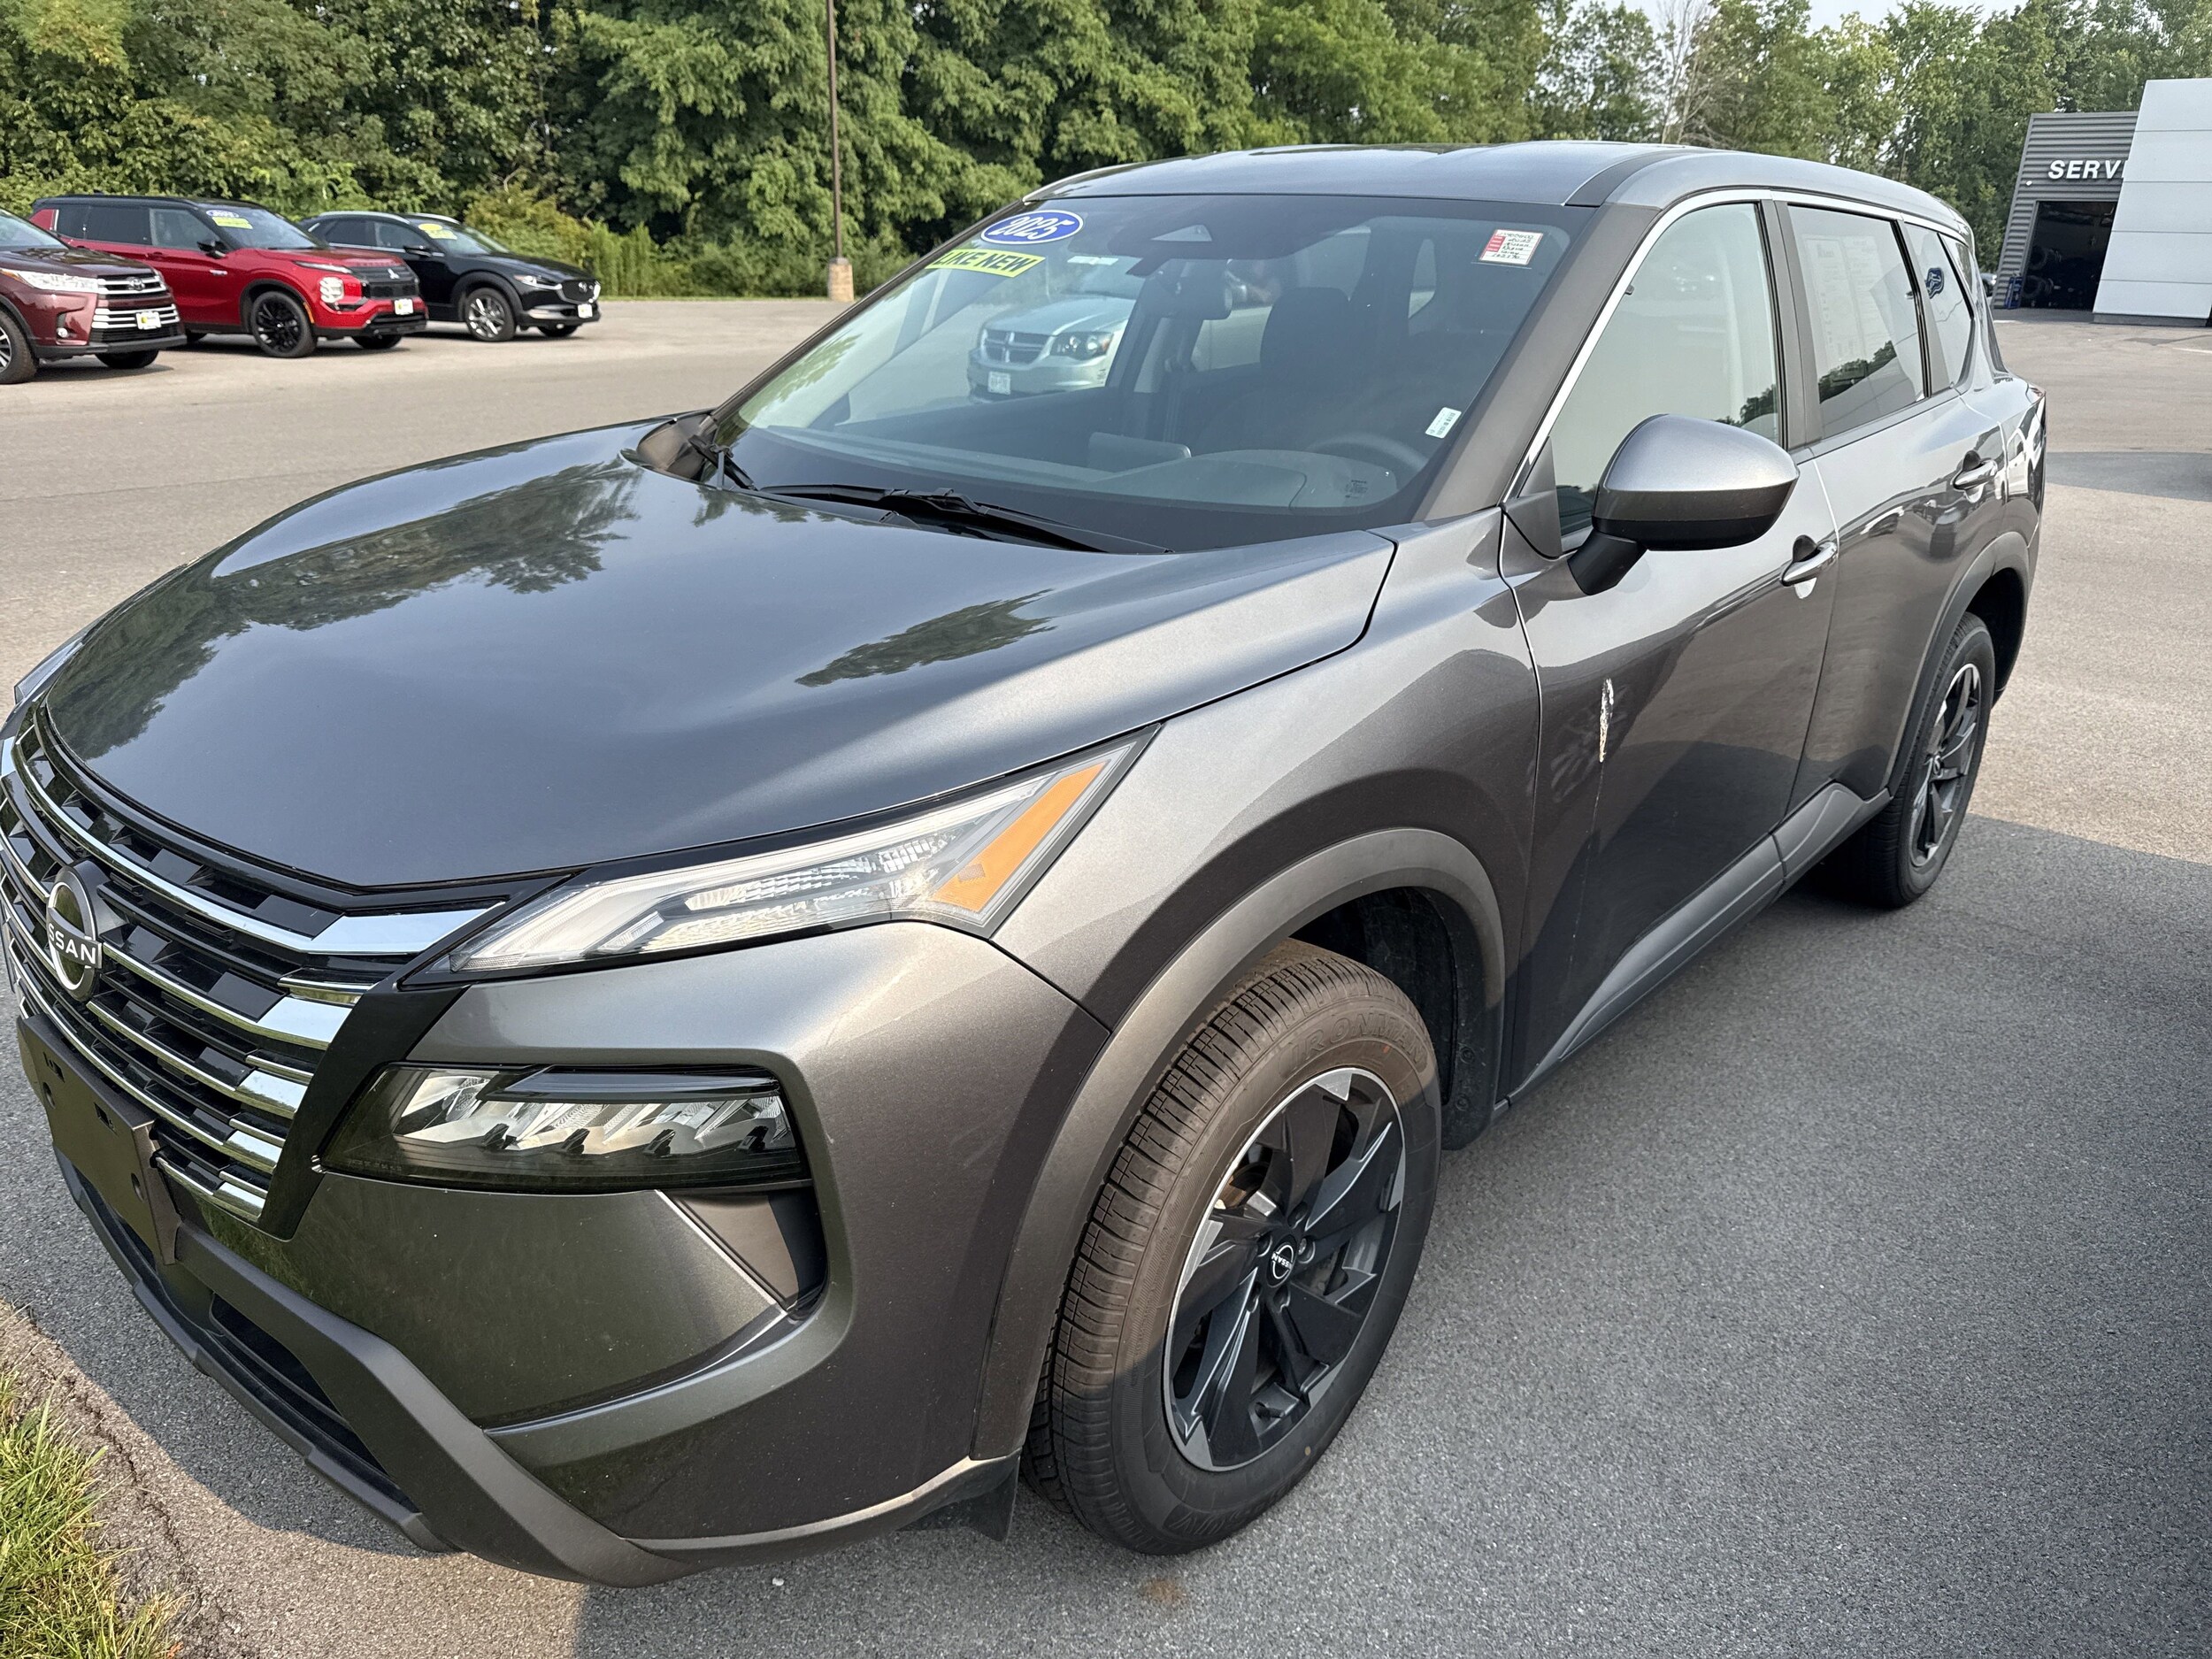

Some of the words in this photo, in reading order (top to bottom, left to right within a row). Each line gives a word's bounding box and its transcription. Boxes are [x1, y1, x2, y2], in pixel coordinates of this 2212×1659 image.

[987, 216, 1075, 240] 2025
[932, 251, 985, 266] LIKE
[975, 253, 1038, 272] NEW
[48, 923, 96, 964] SSAN
[1292, 1013, 1427, 1064] IRONMAN
[1271, 1253, 1293, 1270] SSAN
